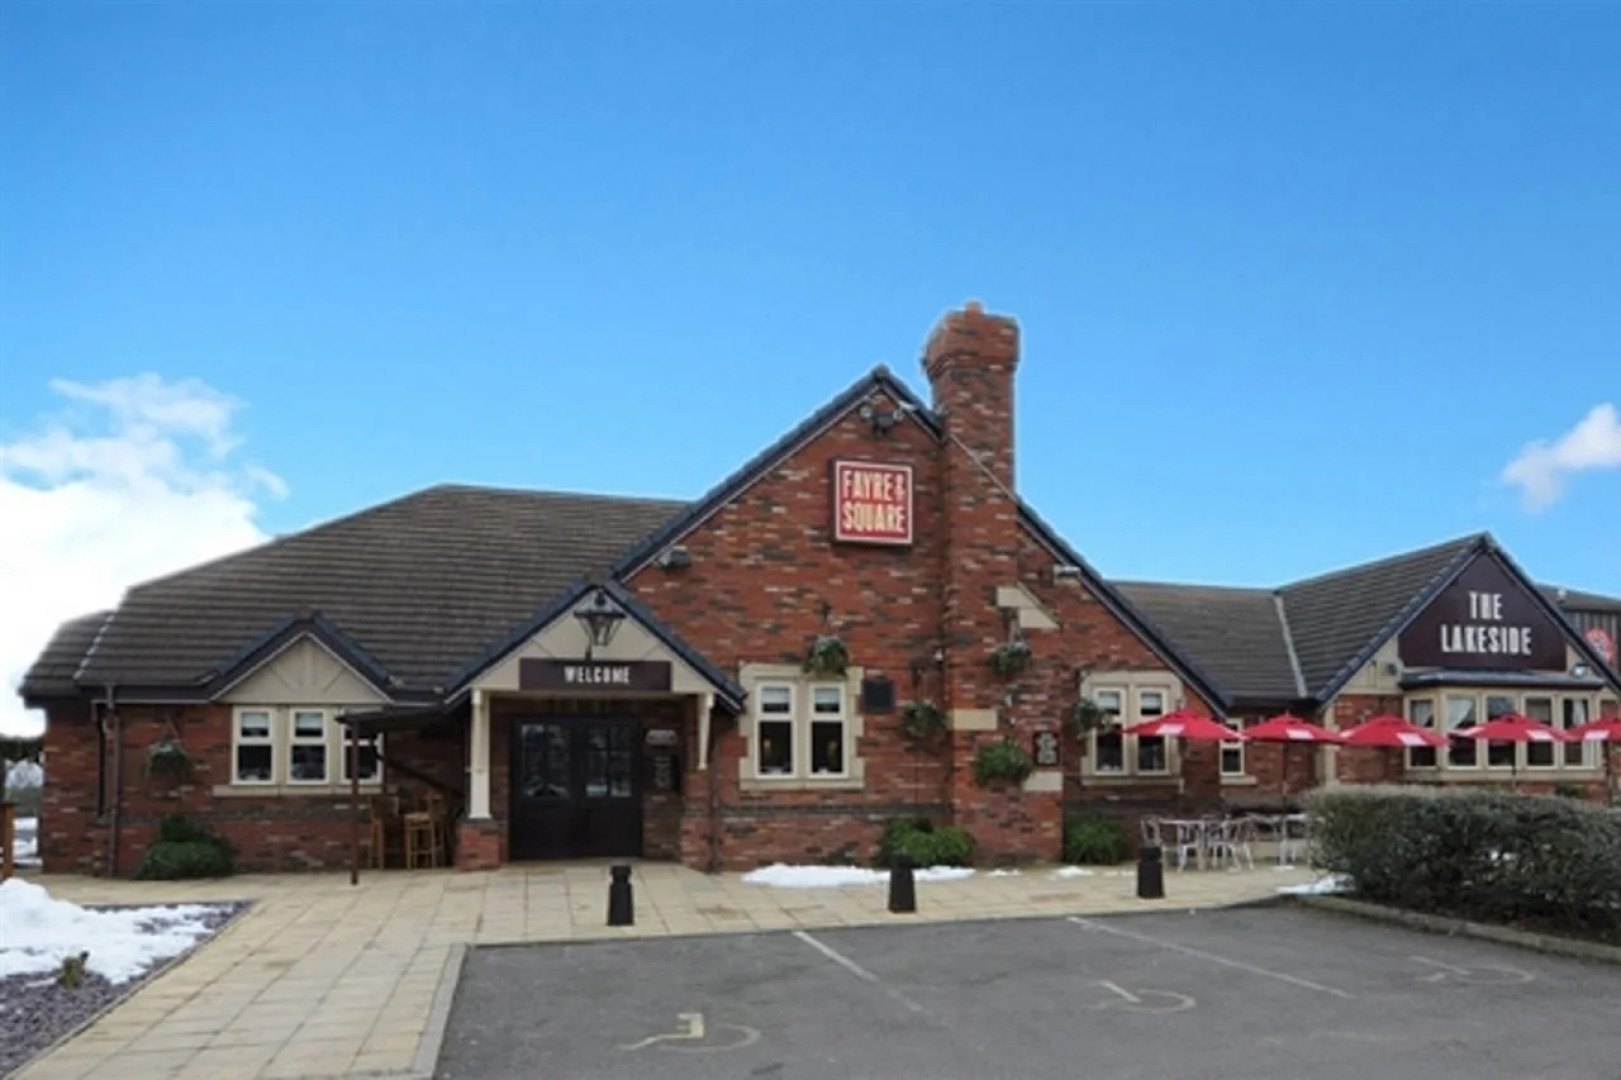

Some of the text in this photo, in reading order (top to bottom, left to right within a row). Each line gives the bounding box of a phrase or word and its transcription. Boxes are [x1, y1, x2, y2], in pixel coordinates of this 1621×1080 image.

[842, 470, 893, 501] FAYRE
[842, 501, 905, 533] SQUARE
[1469, 590, 1503, 620] THE
[1440, 624, 1532, 656] LAKESIDE
[563, 665, 630, 684] WELCOME
